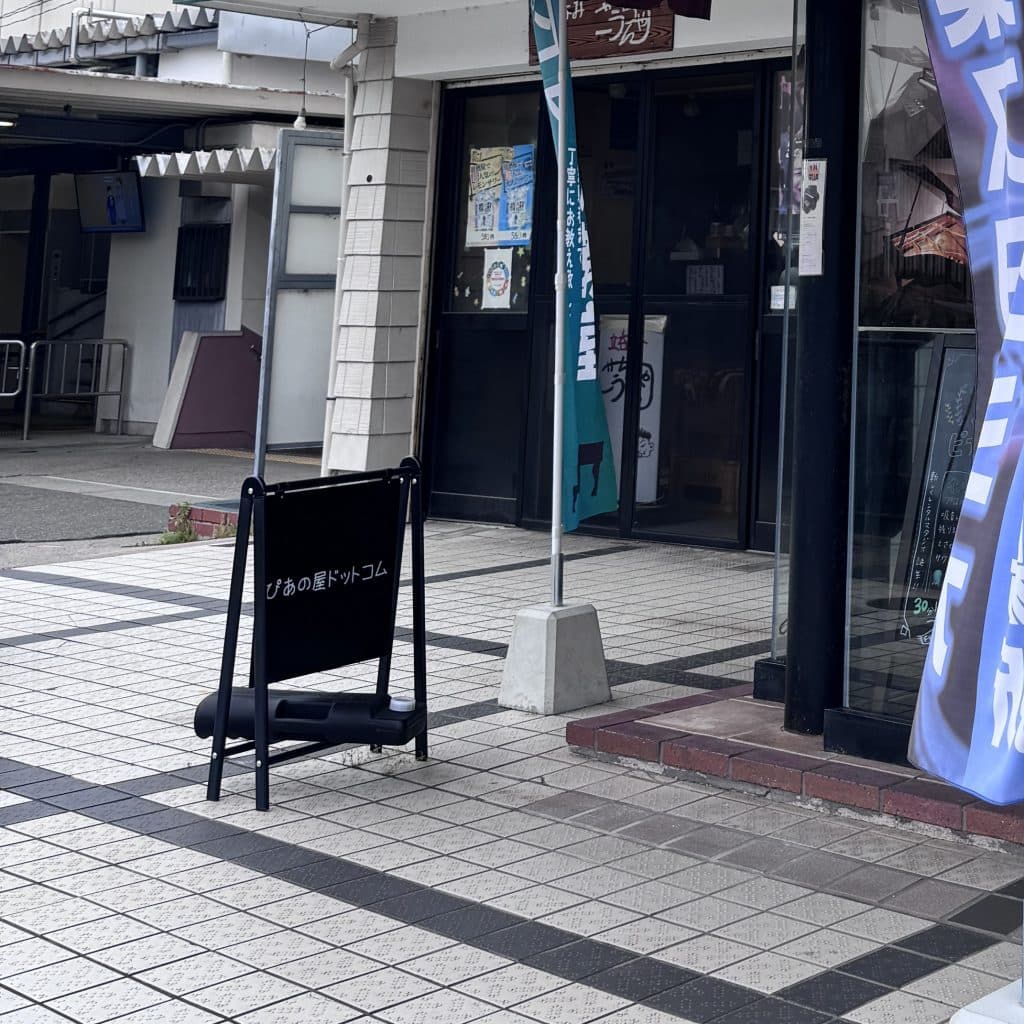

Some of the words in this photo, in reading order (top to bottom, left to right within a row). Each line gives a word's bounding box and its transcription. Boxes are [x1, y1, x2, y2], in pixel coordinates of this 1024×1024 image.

[266, 561, 388, 600] ぴあの屋ドットコム
